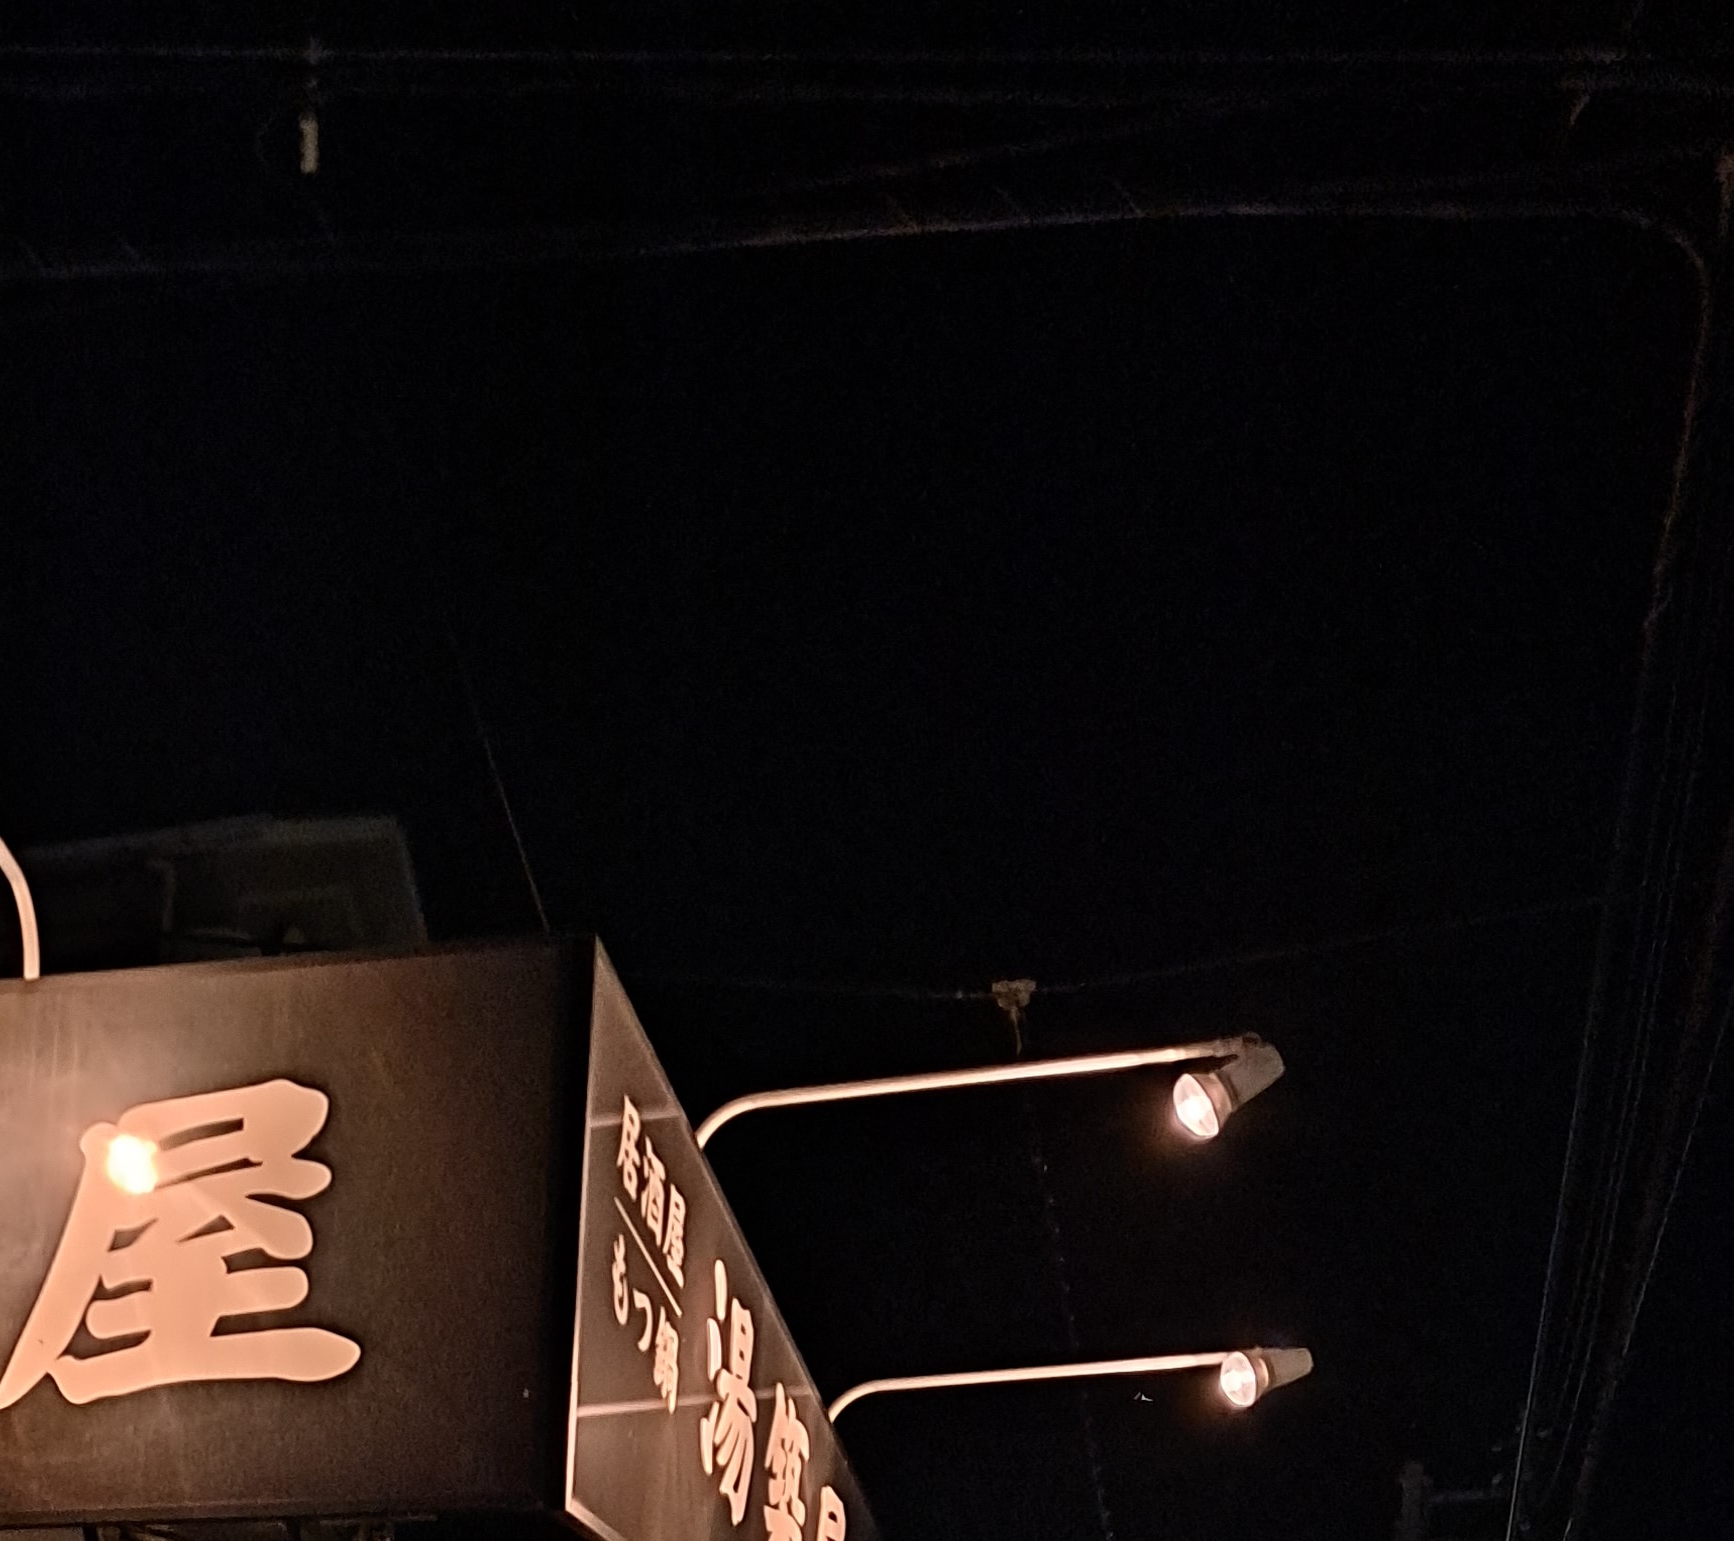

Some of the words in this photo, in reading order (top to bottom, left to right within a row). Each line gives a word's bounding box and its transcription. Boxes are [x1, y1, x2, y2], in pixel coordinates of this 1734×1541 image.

[617, 1094, 686, 1289] 居酒屋
[611, 1233, 680, 1414] もつ鍋
